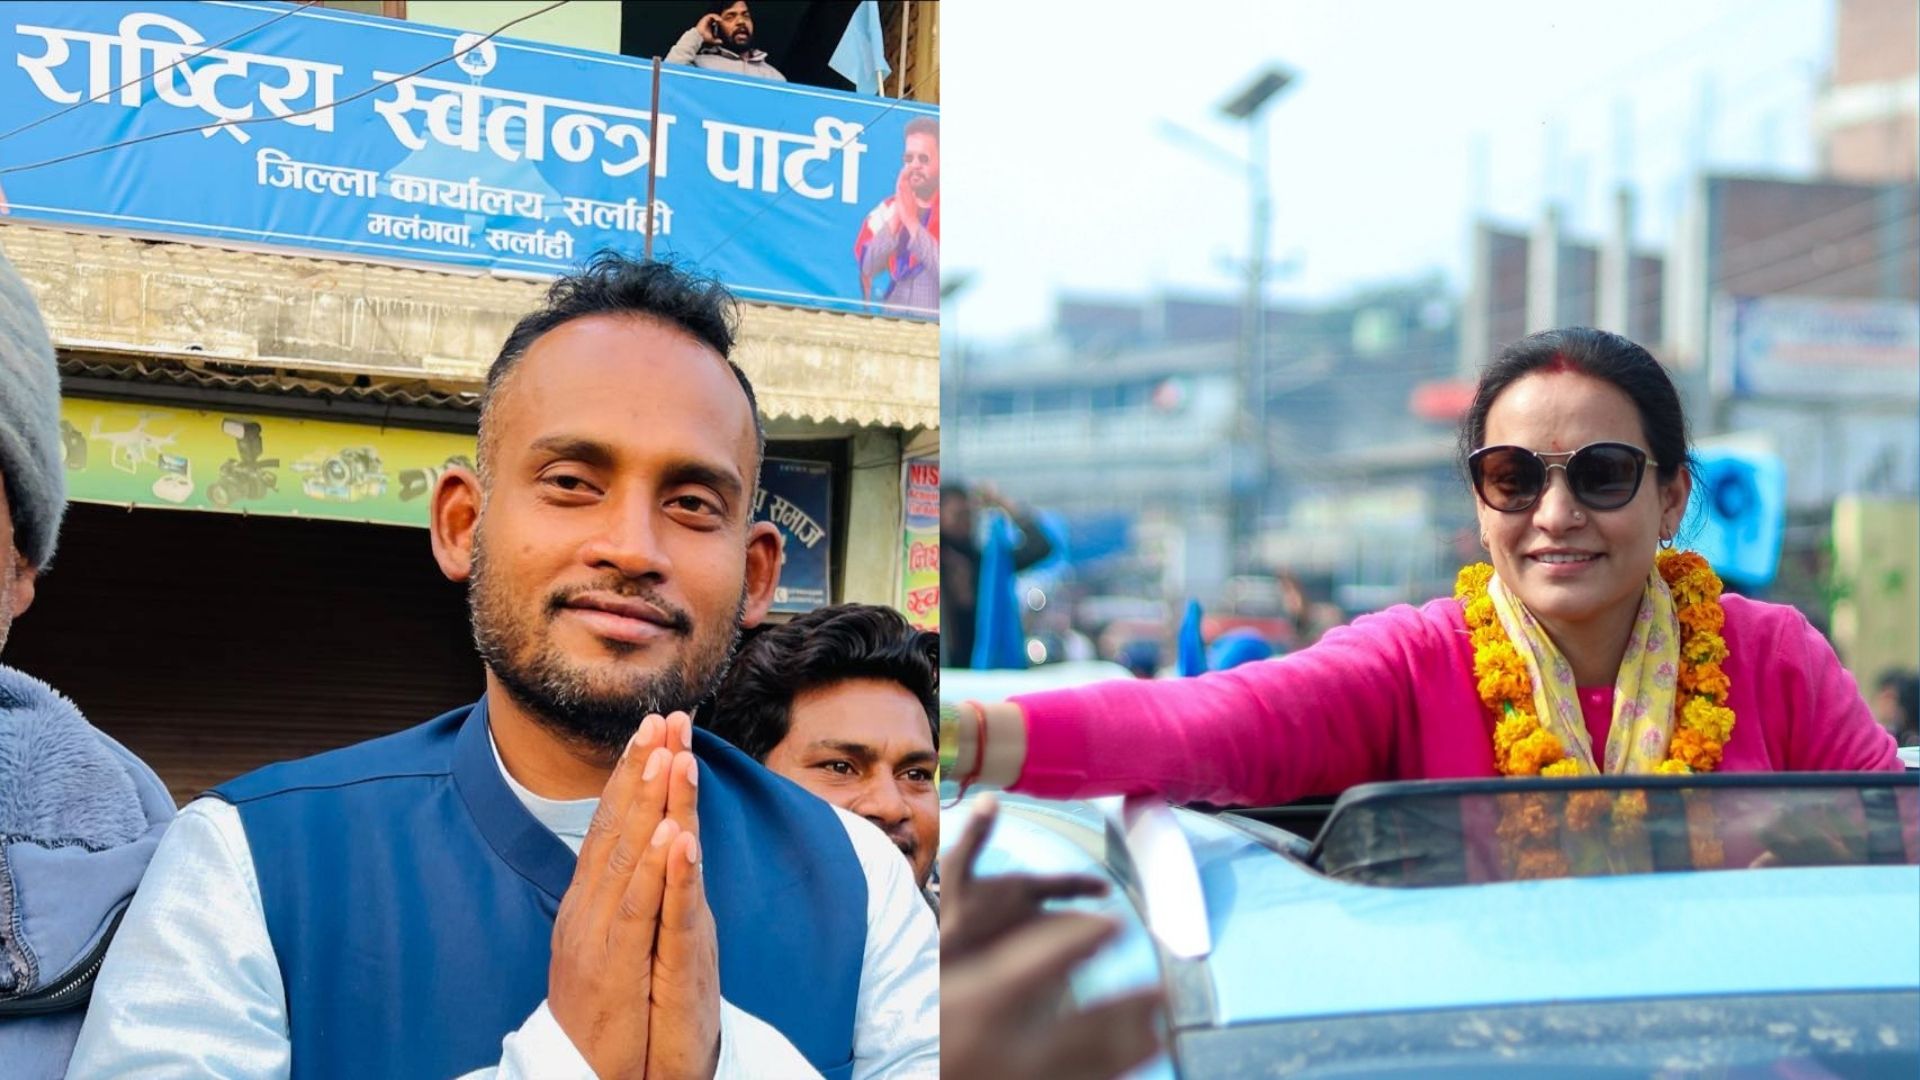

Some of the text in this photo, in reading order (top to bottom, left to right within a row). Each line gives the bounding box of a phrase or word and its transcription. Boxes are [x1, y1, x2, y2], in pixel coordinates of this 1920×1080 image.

[15, 12, 868, 204] राष्ट्रिय स्वतन्त्र पार्टी
[256, 147, 379, 198] जिल्ला
[563, 198, 674, 236] सर्लाही
[485, 228, 575, 260] सर्लाही
[769, 494, 826, 549] समाज
